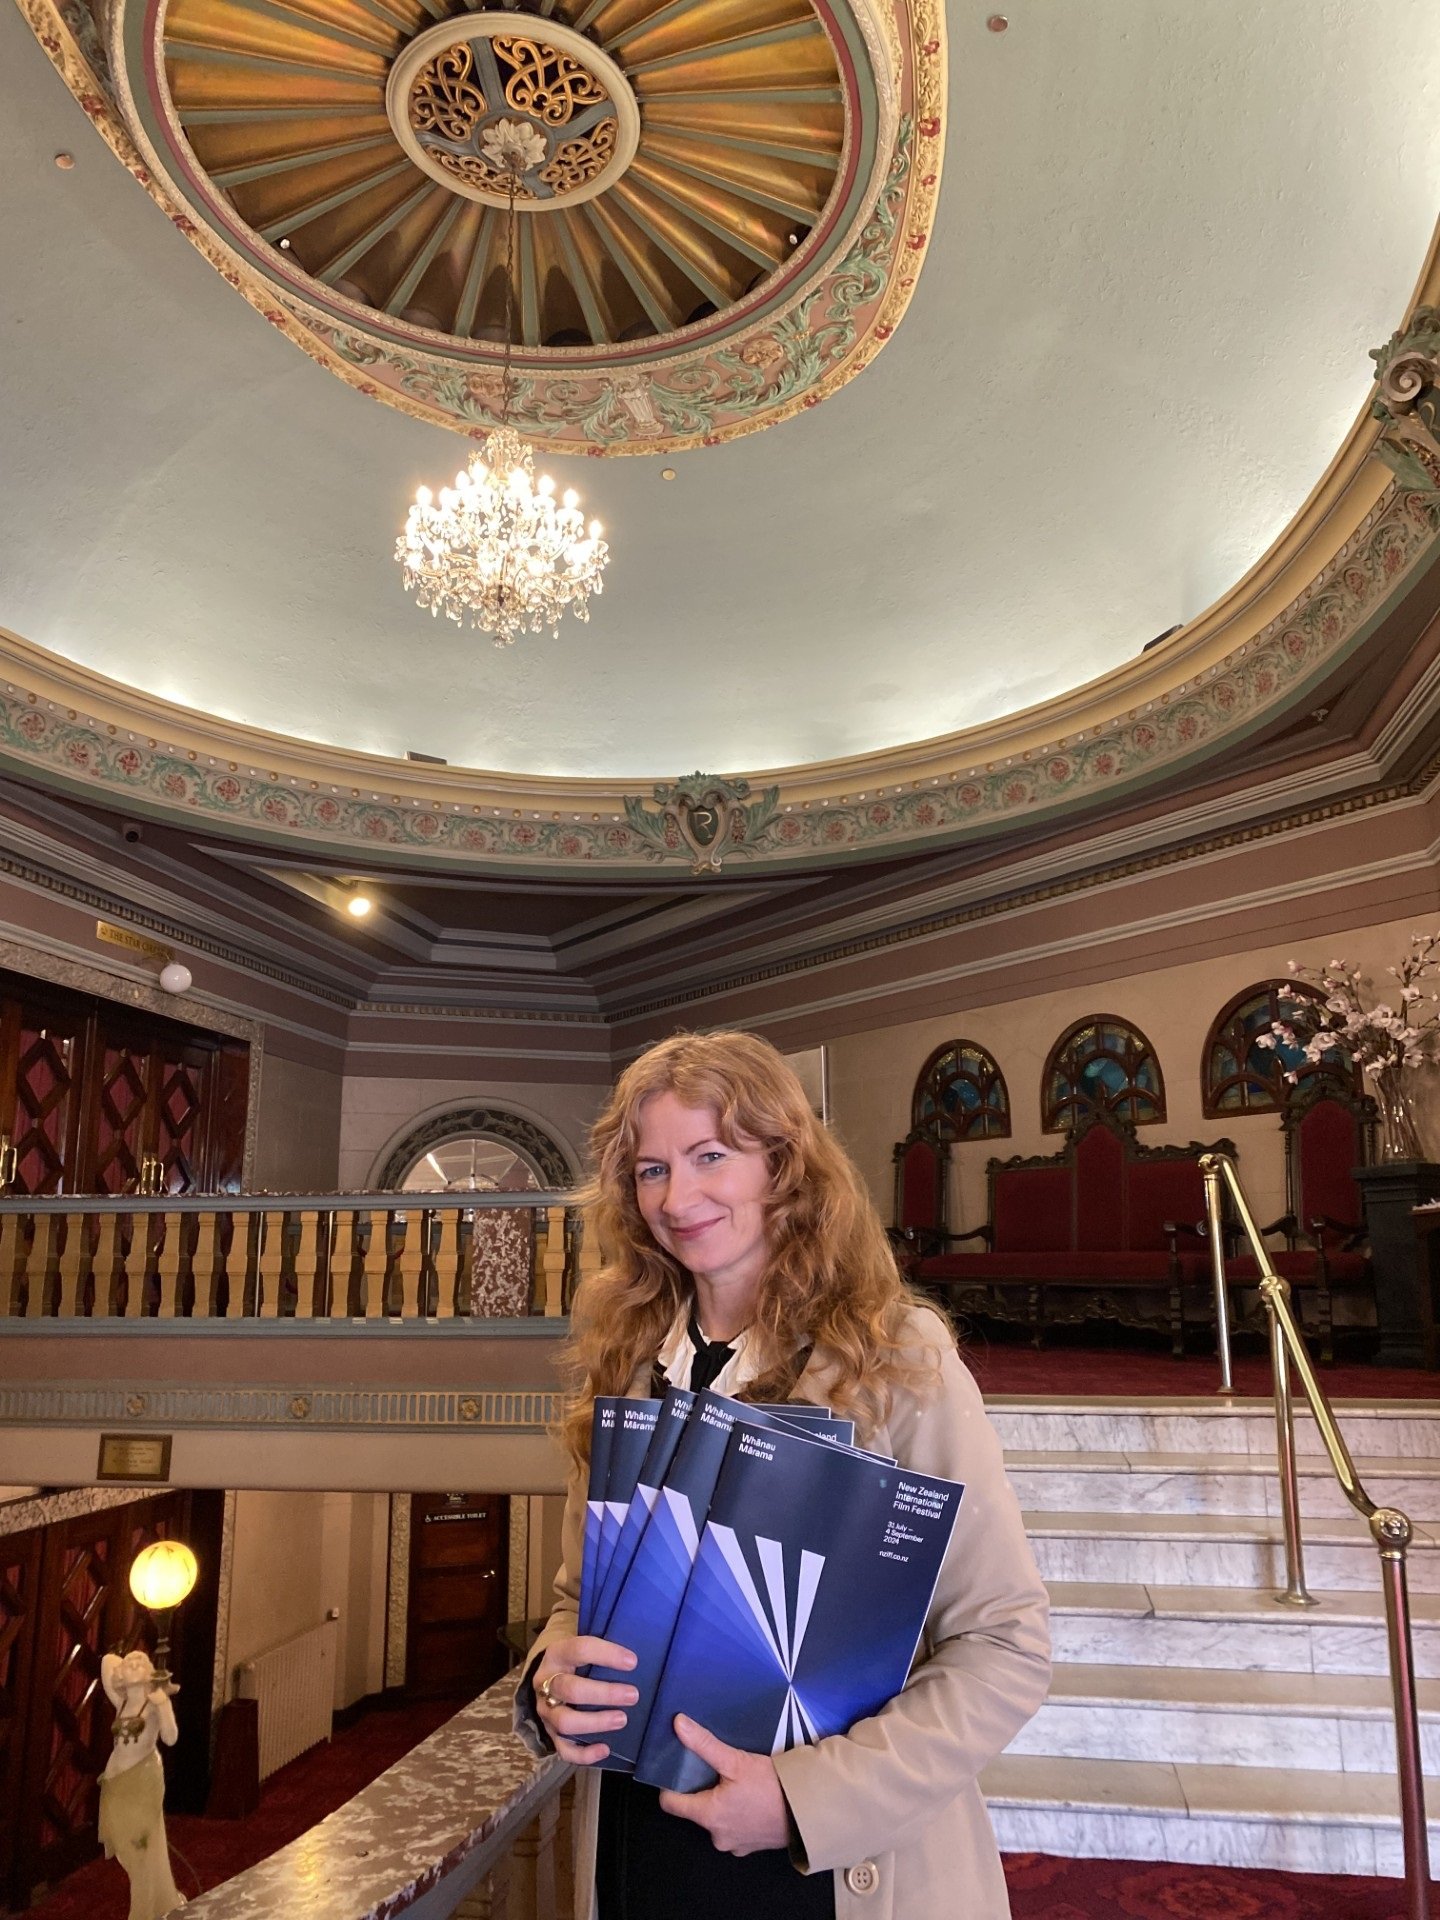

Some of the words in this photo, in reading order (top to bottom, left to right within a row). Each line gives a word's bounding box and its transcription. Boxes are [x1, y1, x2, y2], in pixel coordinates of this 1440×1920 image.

[110, 929, 123, 942] THE
[742, 1433, 776, 1451] Whānau
[739, 1443, 773, 1461] Mārama
[898, 1481, 917, 1493] New
[918, 1486, 949, 1501] Zealand
[895, 1491, 944, 1510] International
[893, 1500, 910, 1511] Film
[911, 1505, 941, 1519] Festival
[895, 1522, 907, 1532] July
[883, 1535, 900, 1545] 2024
[891, 1529, 924, 1543] September
[879, 1550, 909, 1562] nziff.co.nz
